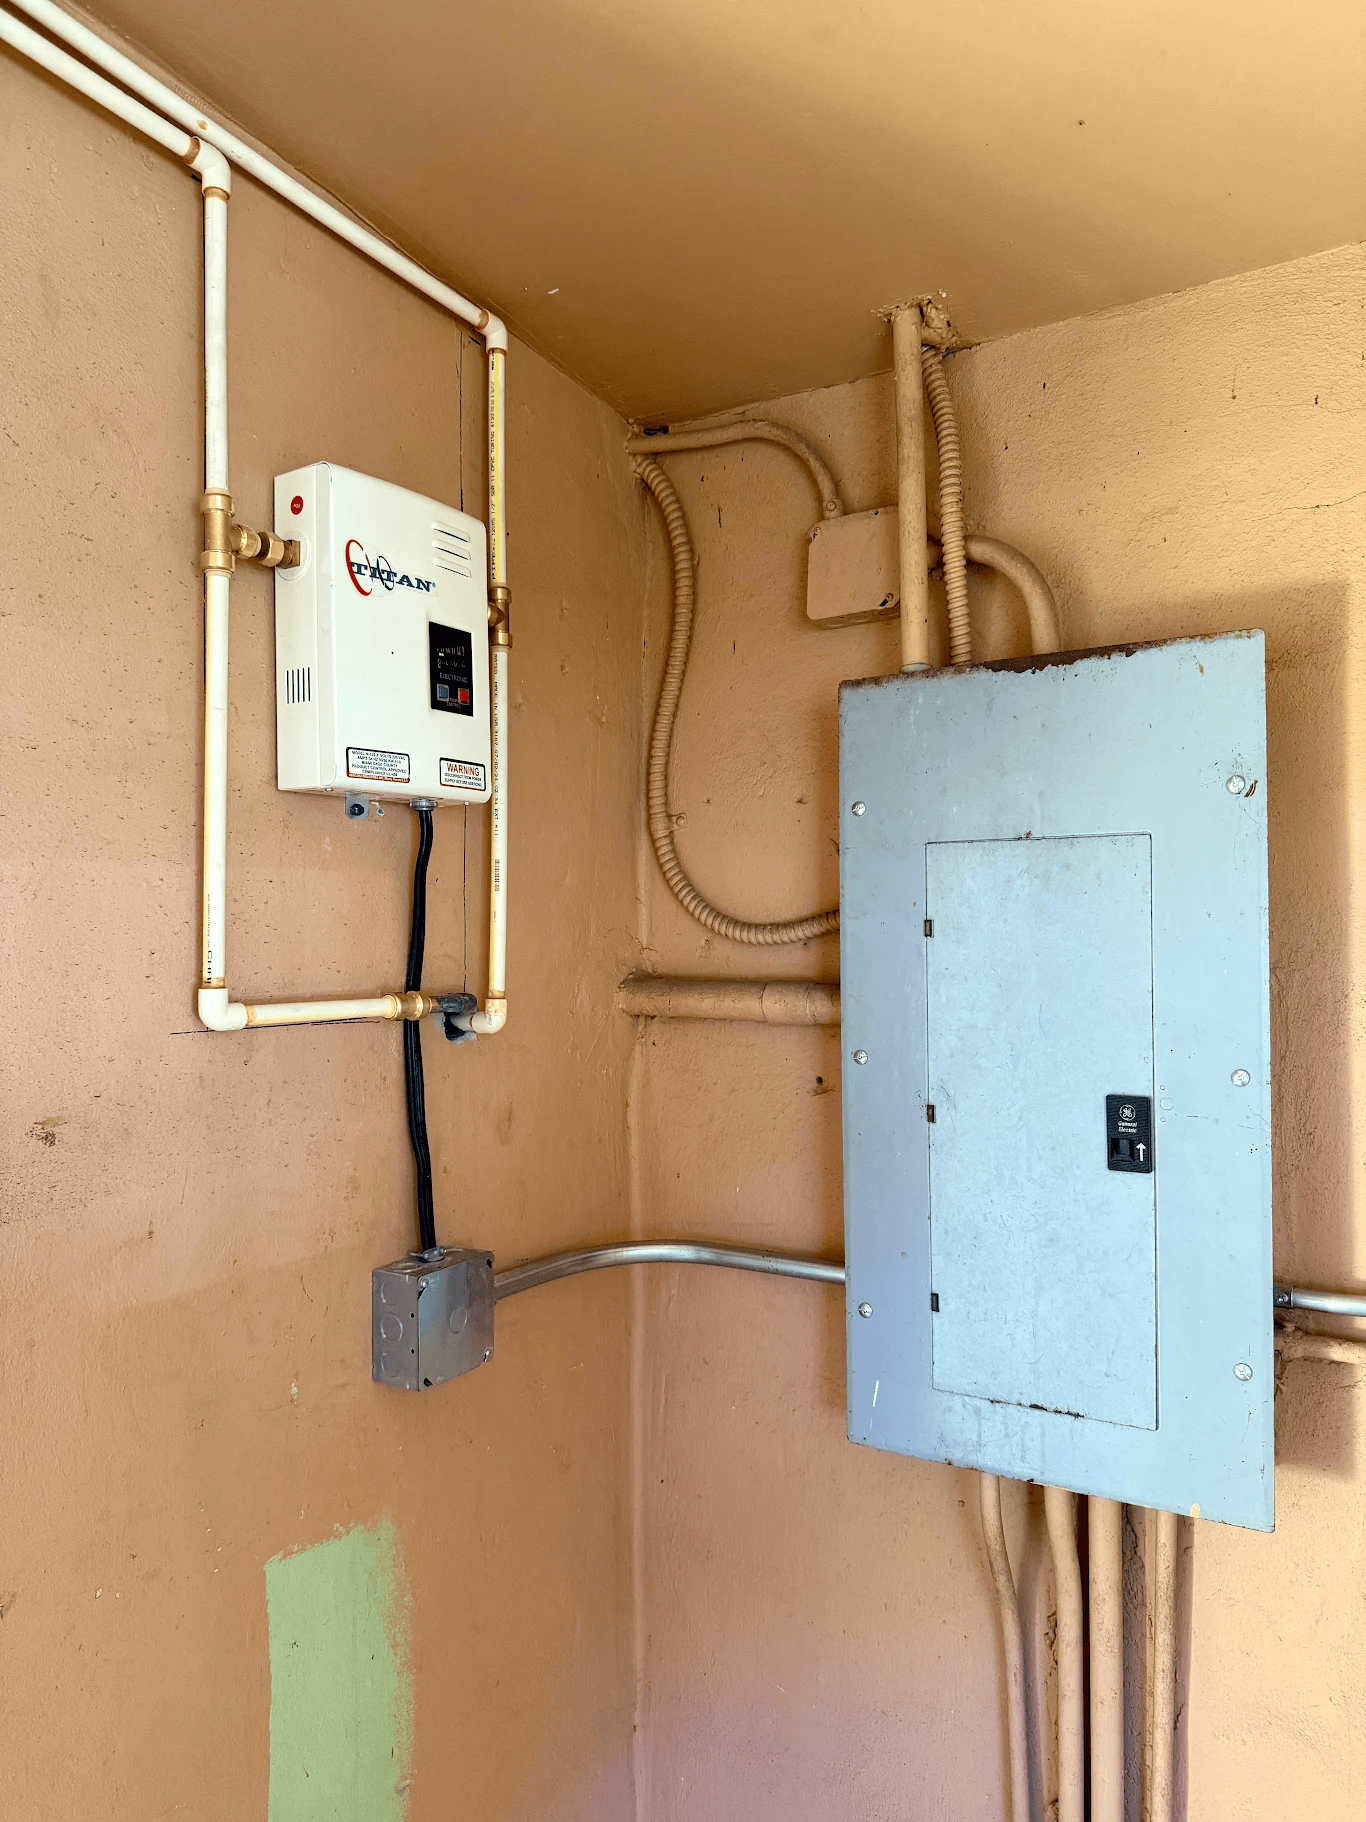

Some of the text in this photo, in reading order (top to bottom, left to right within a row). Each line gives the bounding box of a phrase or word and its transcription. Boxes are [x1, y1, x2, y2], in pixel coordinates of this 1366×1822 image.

[350, 562, 431, 592] TITAN
[440, 672, 467, 683] ELECTRONIC
[447, 763, 480, 776] WARNING
[1117, 1120, 1138, 1128] General
